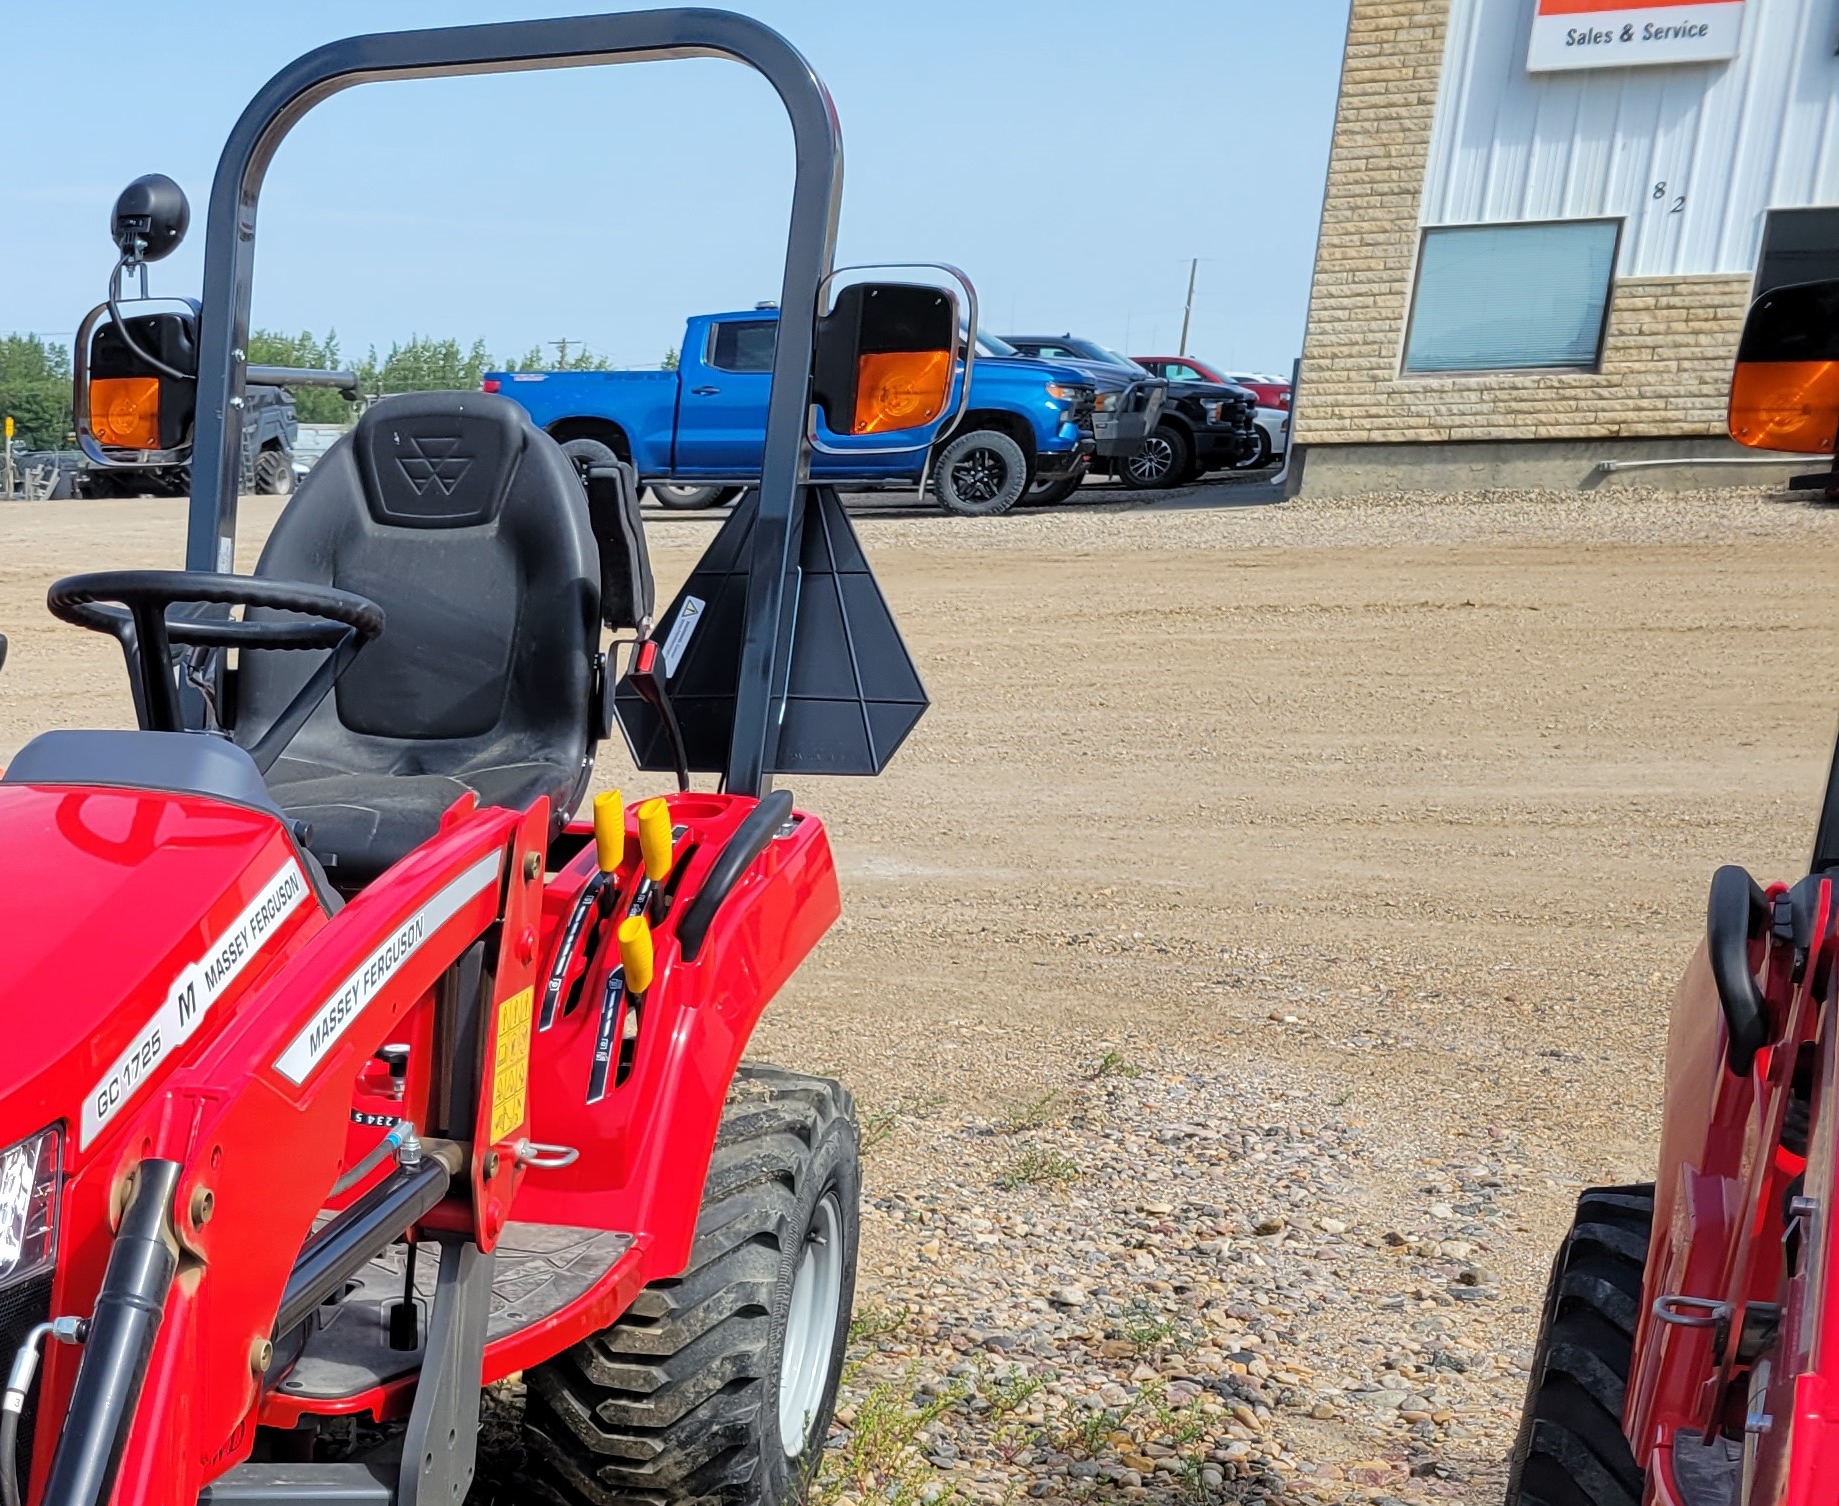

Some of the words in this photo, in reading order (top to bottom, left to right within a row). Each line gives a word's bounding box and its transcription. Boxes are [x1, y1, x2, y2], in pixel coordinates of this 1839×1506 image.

[1565, 27, 1613, 47] Sales
[1619, 23, 1635, 43] &
[1641, 20, 1709, 41] Service
[96, 1077, 120, 1119] GC
[122, 1028, 161, 1088] 1725
[204, 926, 250, 992] MASSEY
[249, 872, 300, 941] FERGUSON
[309, 979, 360, 1057] MASSEY
[363, 915, 424, 995] FERGUSON
